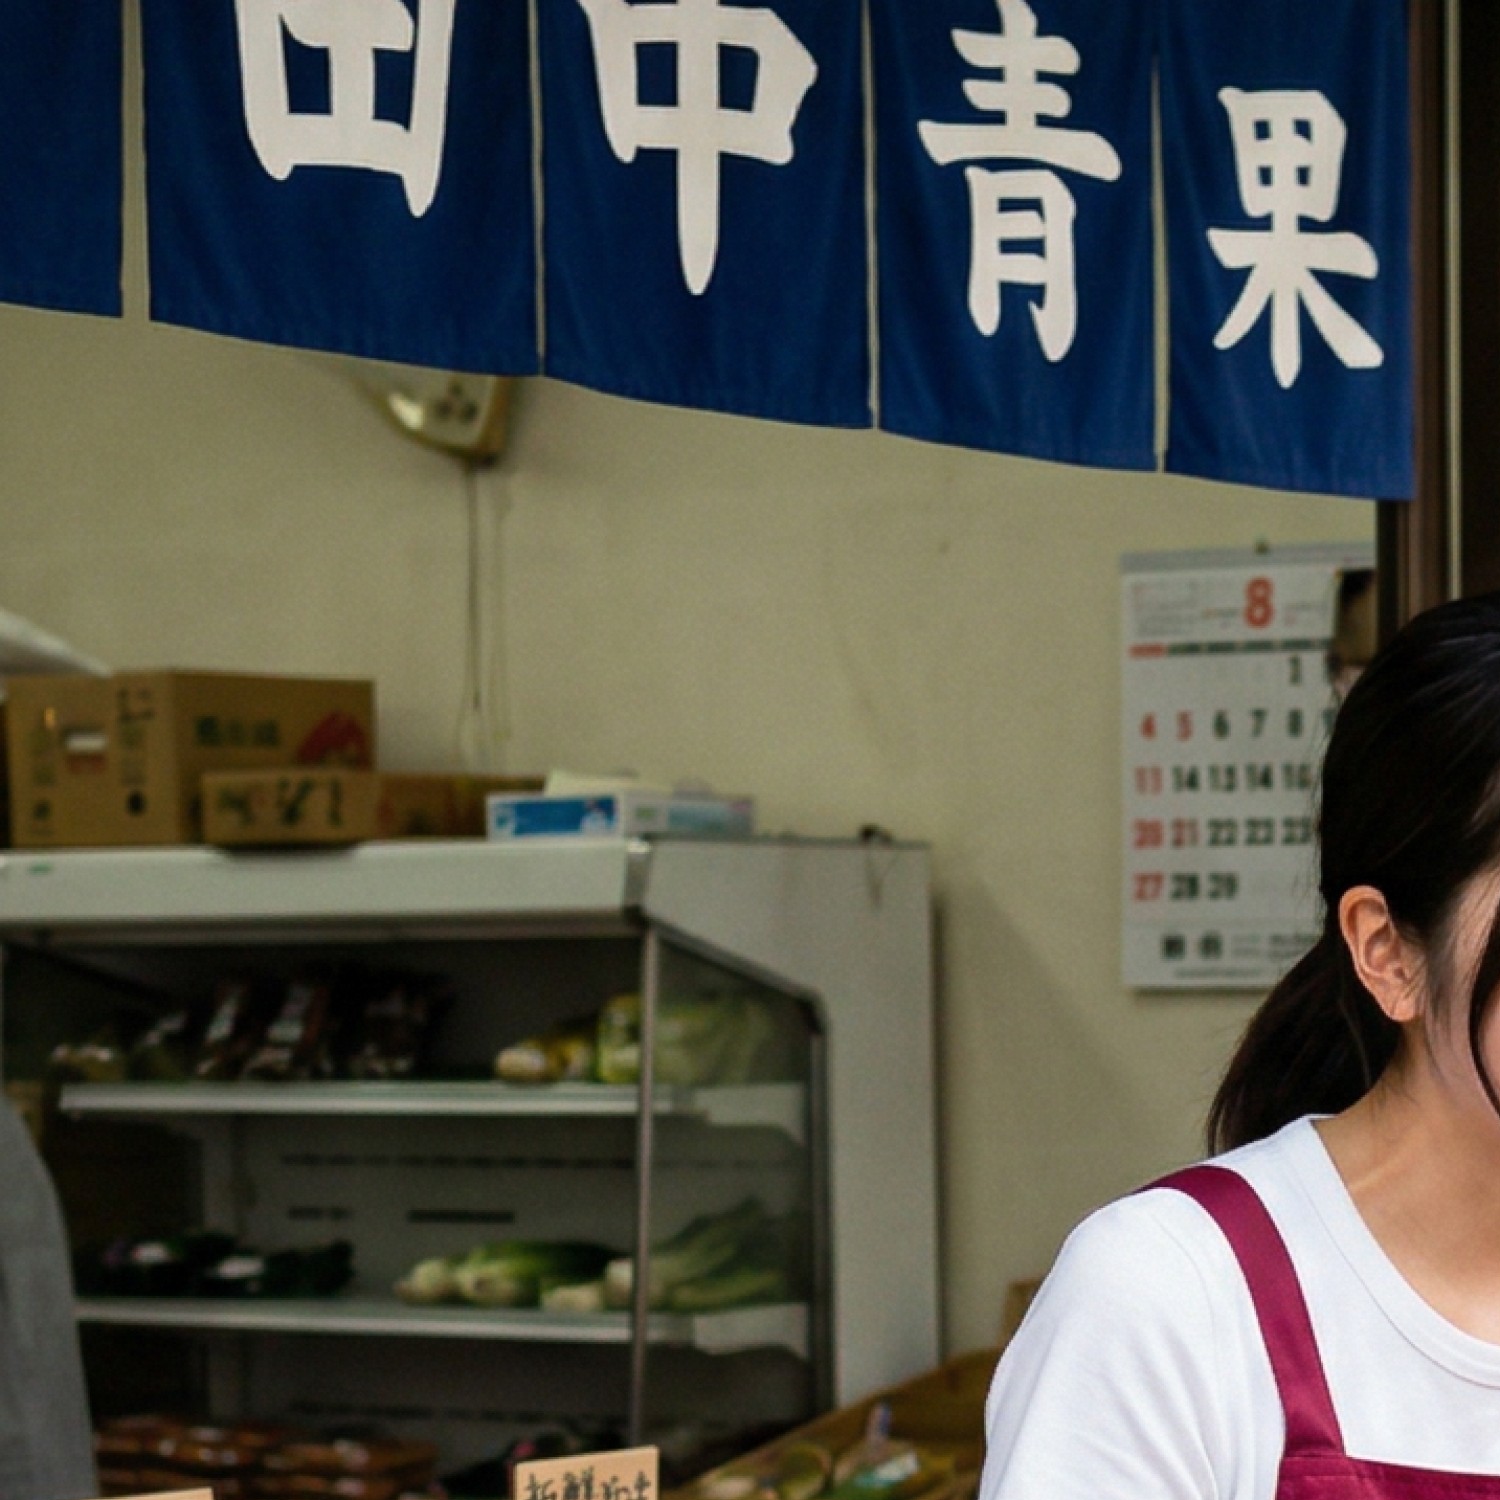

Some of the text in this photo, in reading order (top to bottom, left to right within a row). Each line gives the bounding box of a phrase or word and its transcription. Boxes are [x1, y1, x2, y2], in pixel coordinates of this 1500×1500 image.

[1243, 576, 1275, 630] 8
[1141, 713, 1156, 740] 4
[1177, 711, 1193, 740] 5
[1212, 709, 1230, 740] 6
[1249, 708, 1268, 738] 7
[1287, 708, 1304, 739] 8
